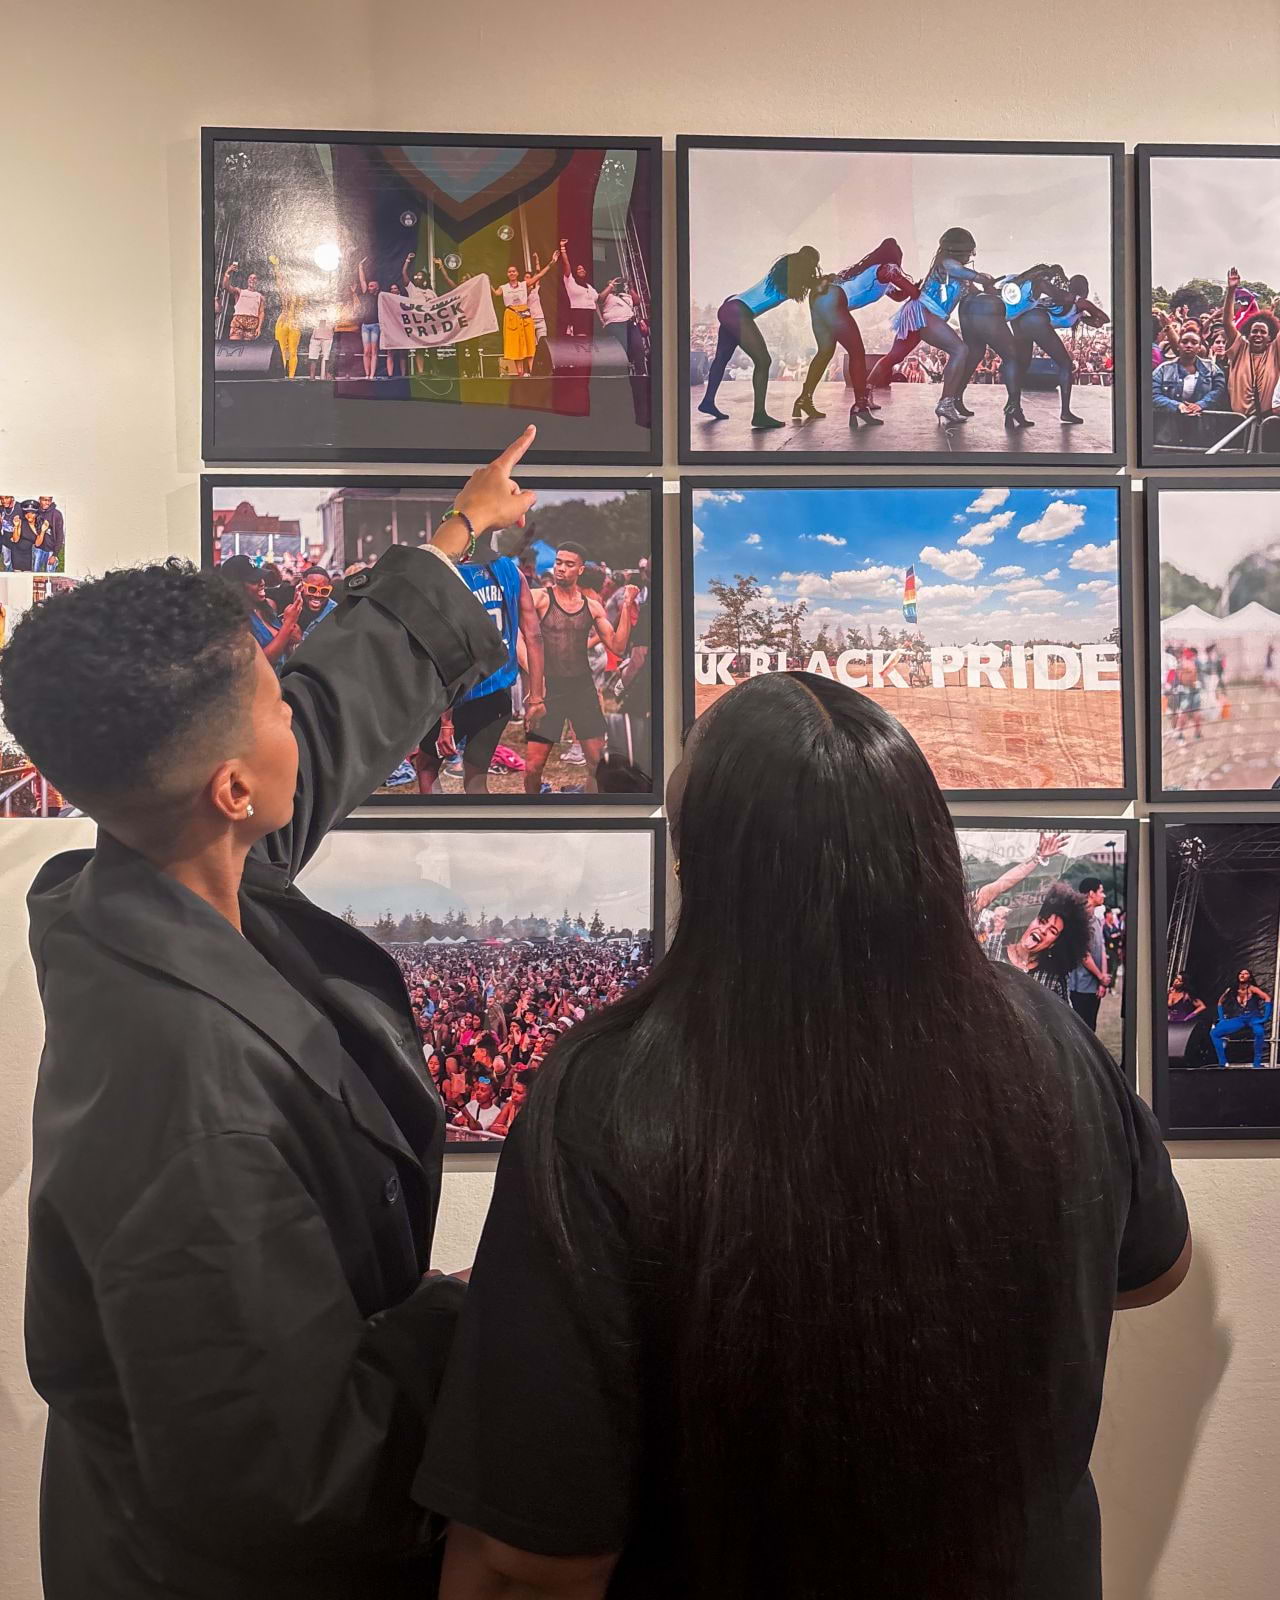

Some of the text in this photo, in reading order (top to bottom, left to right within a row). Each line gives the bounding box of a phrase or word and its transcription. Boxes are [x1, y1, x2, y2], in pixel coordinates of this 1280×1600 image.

[401, 302, 464, 325] BLACK
[404, 316, 469, 337] PRIDE
[695, 652, 736, 686] UK
[930, 644, 1121, 690] PRIDE
